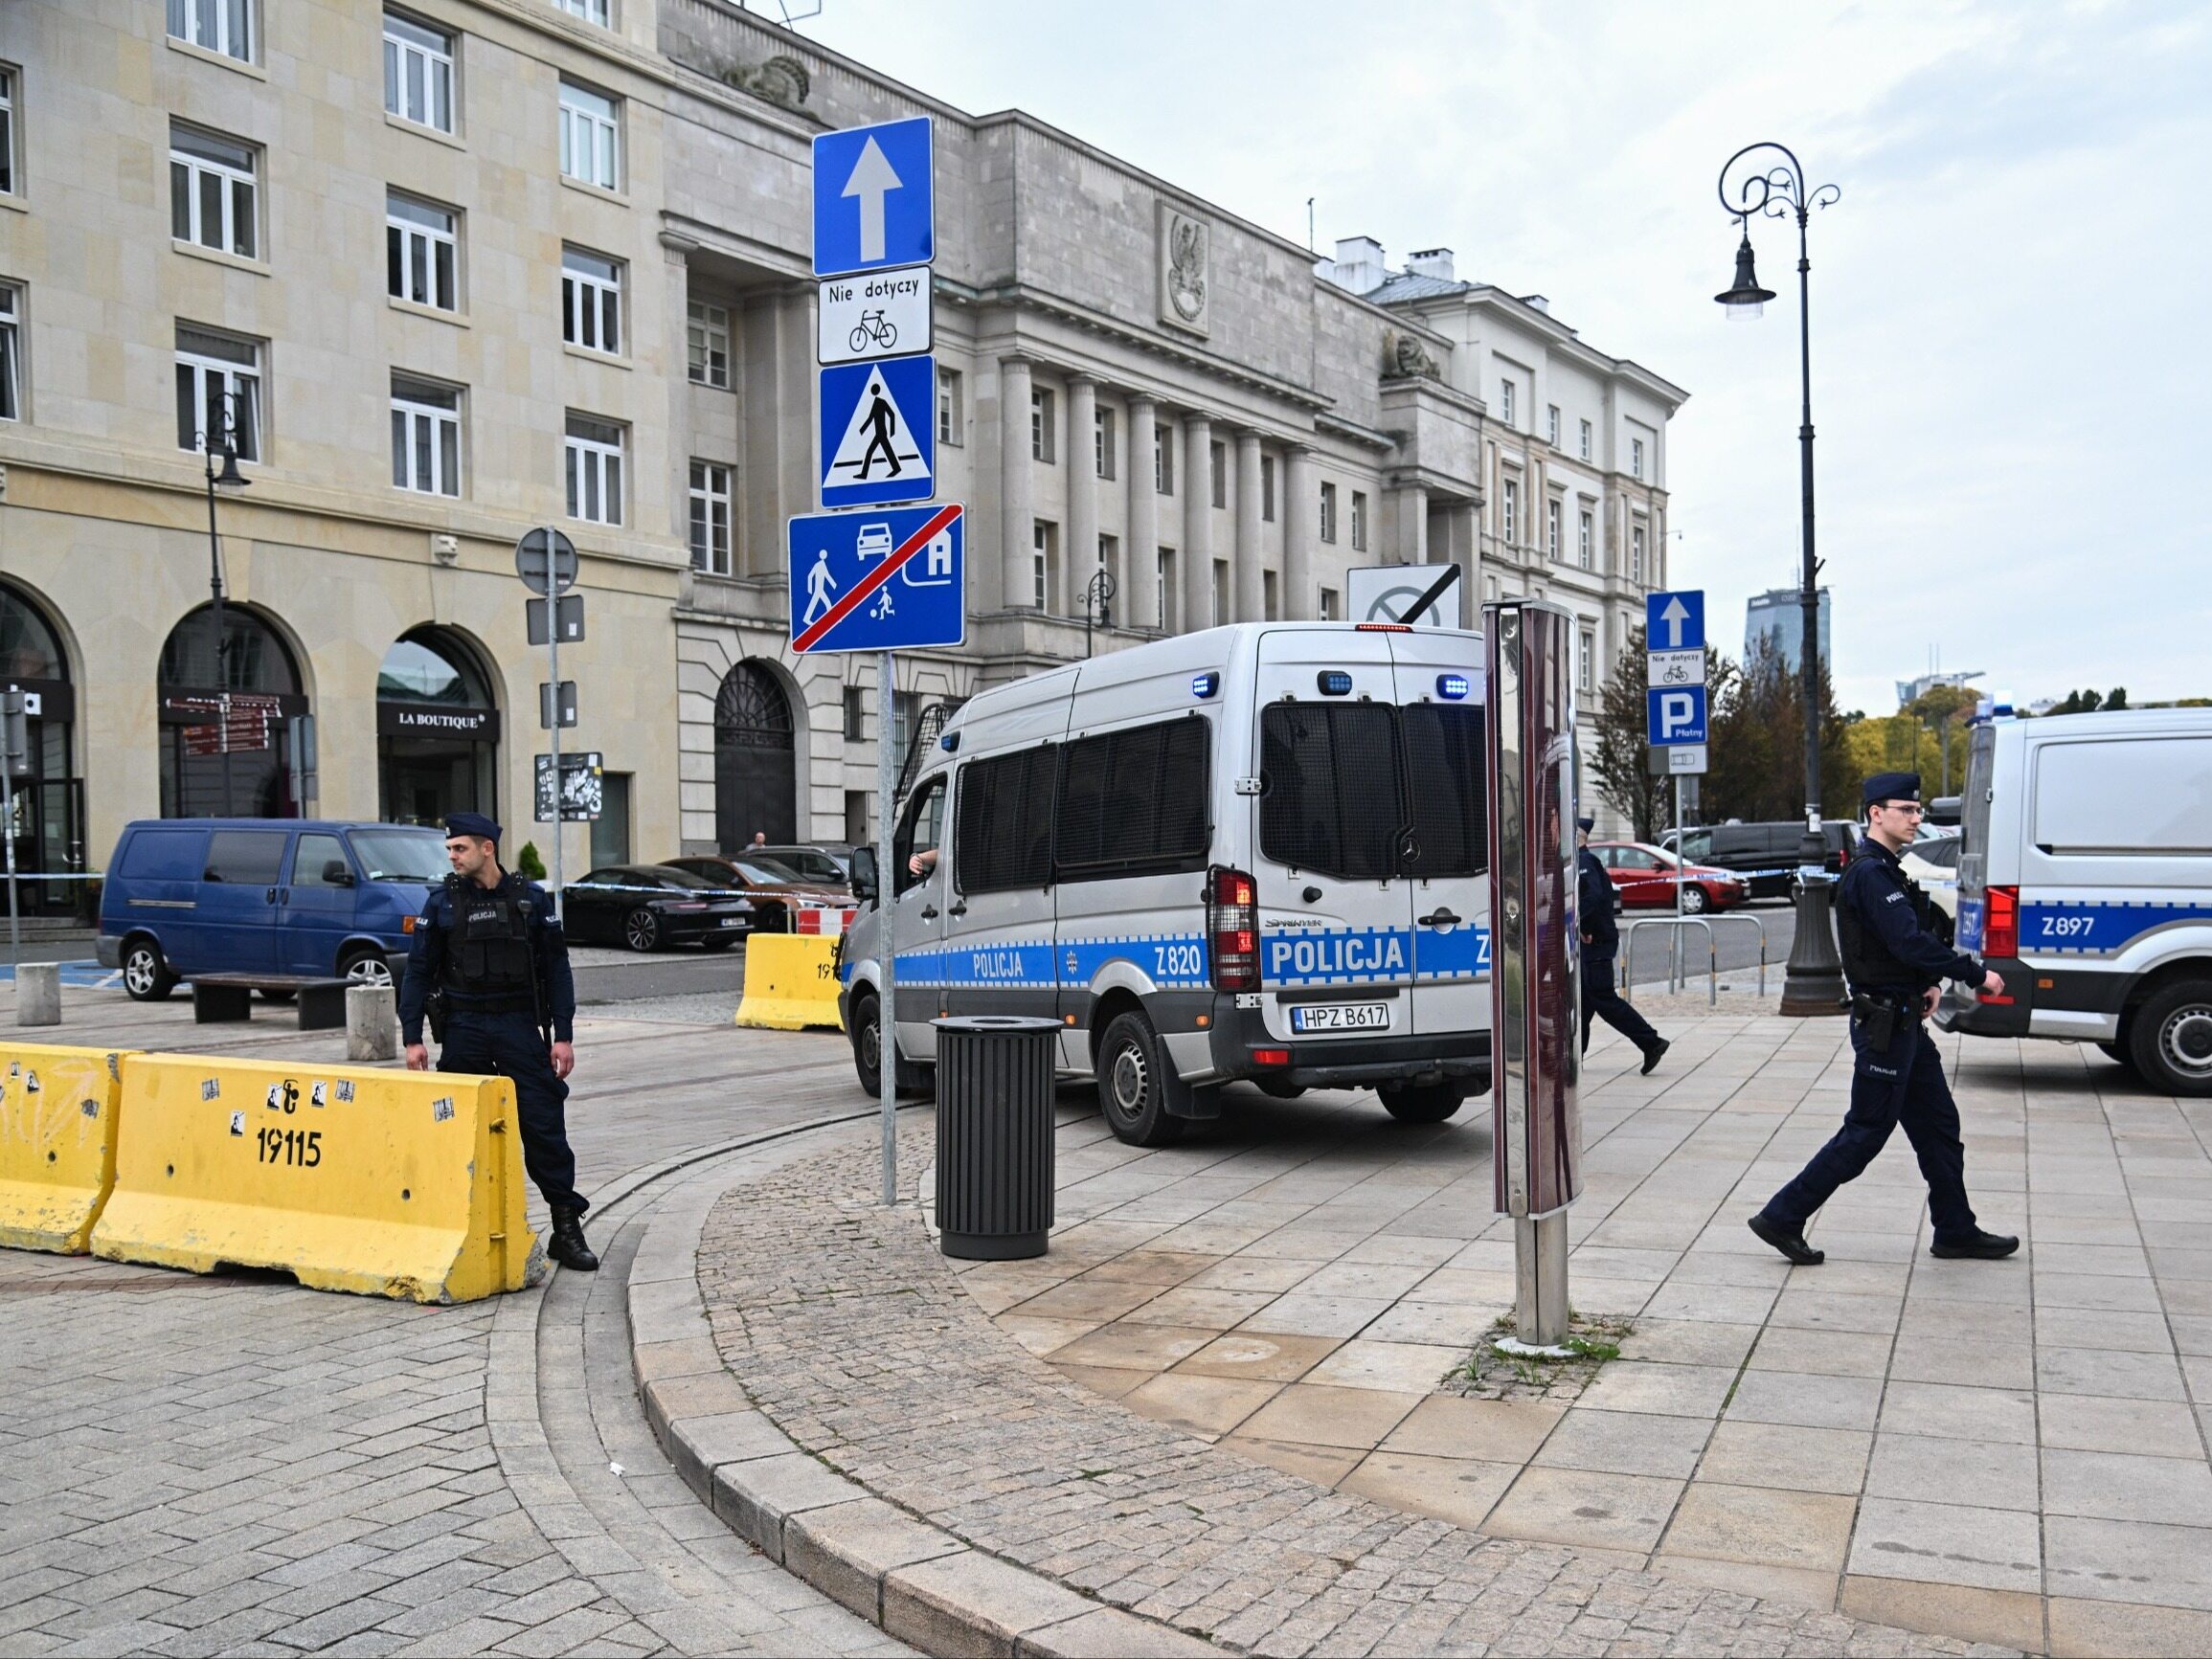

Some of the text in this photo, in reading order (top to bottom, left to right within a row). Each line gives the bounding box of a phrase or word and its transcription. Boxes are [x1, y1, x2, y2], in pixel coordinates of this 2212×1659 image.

[829, 280, 919, 303] Nie dotyczy
[1670, 653, 1699, 662] dotyczy
[398, 713, 479, 729] LA BOUTIQUE
[1660, 692, 1694, 738] P
[468, 910, 497, 922] POLICJA
[2041, 916, 2095, 936] Z897
[973, 952, 1024, 978] POLICJA
[1272, 937, 1404, 975] POLICJA
[1304, 1006, 1385, 1028] HPZ B617
[257, 1127, 322, 1168] 19115
